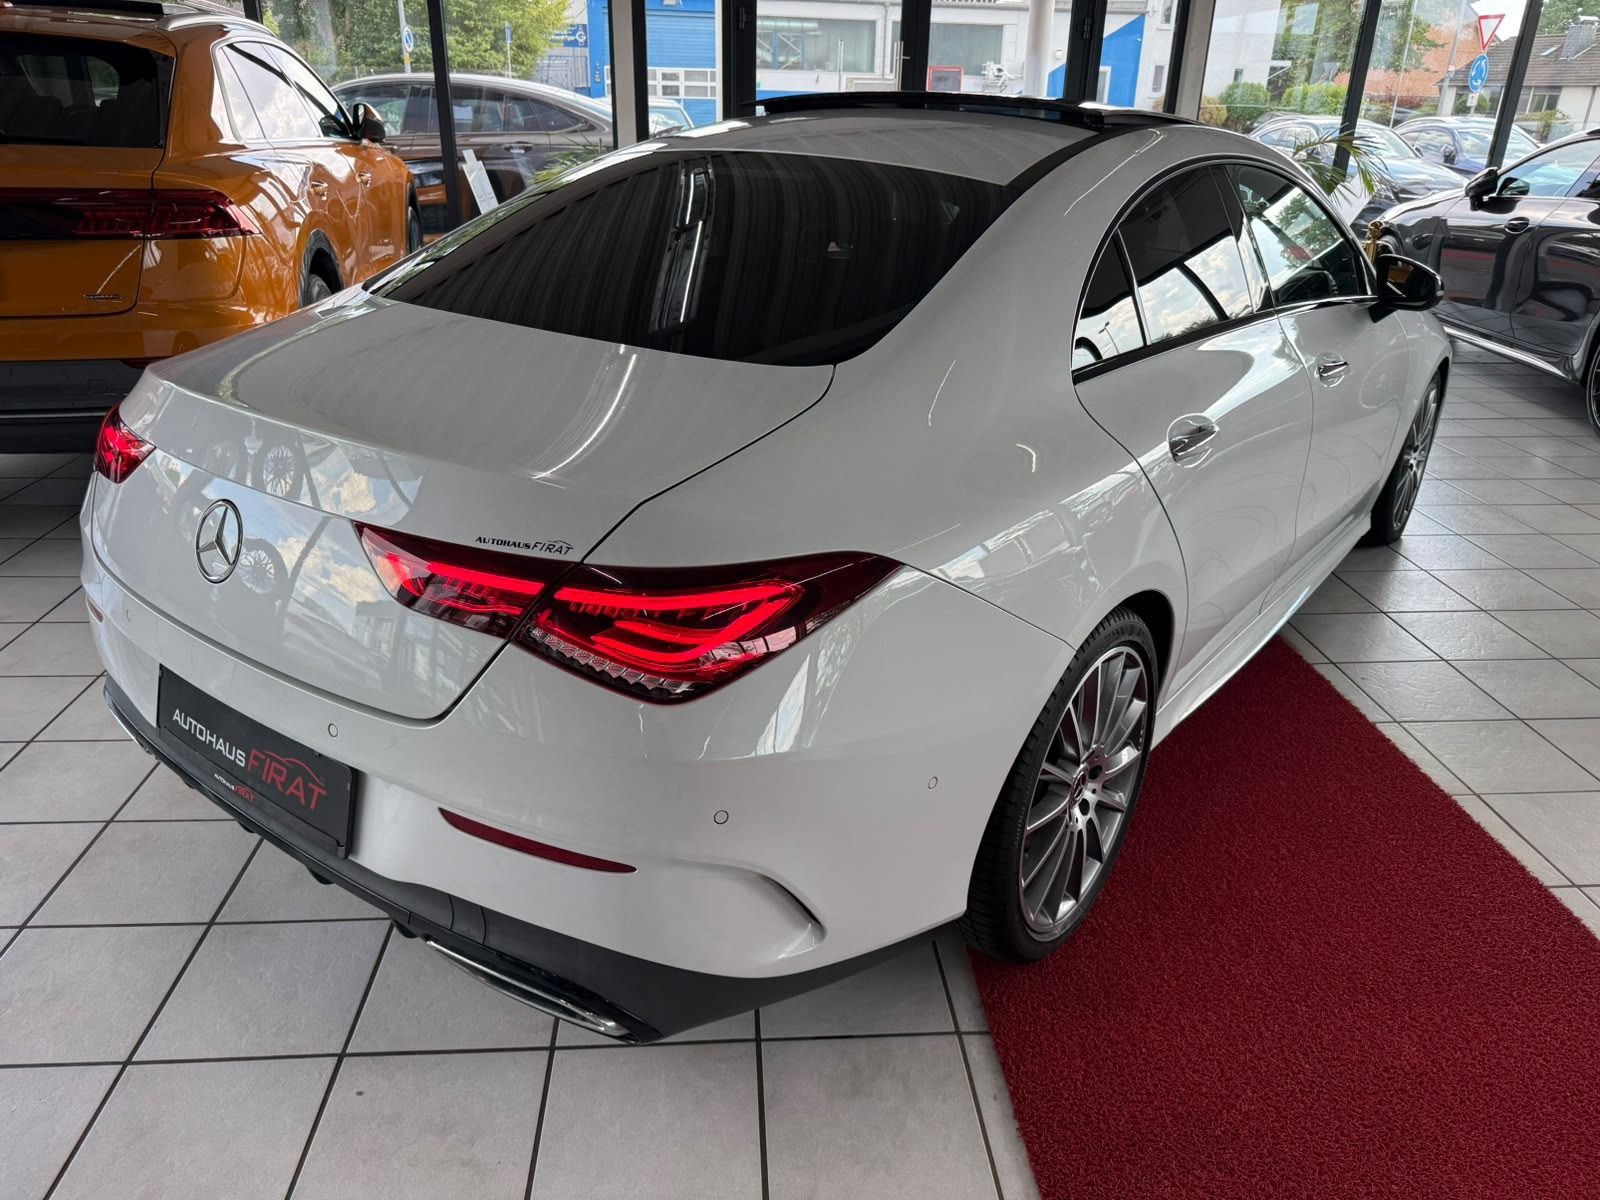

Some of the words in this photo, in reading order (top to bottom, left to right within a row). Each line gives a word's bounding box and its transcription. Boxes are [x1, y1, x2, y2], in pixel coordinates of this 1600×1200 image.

[475, 536, 531, 550] AUTOHAUS
[531, 541, 574, 556] FIRAT
[172, 708, 247, 768] AUTOHAUS
[247, 748, 328, 811] FIRAT
